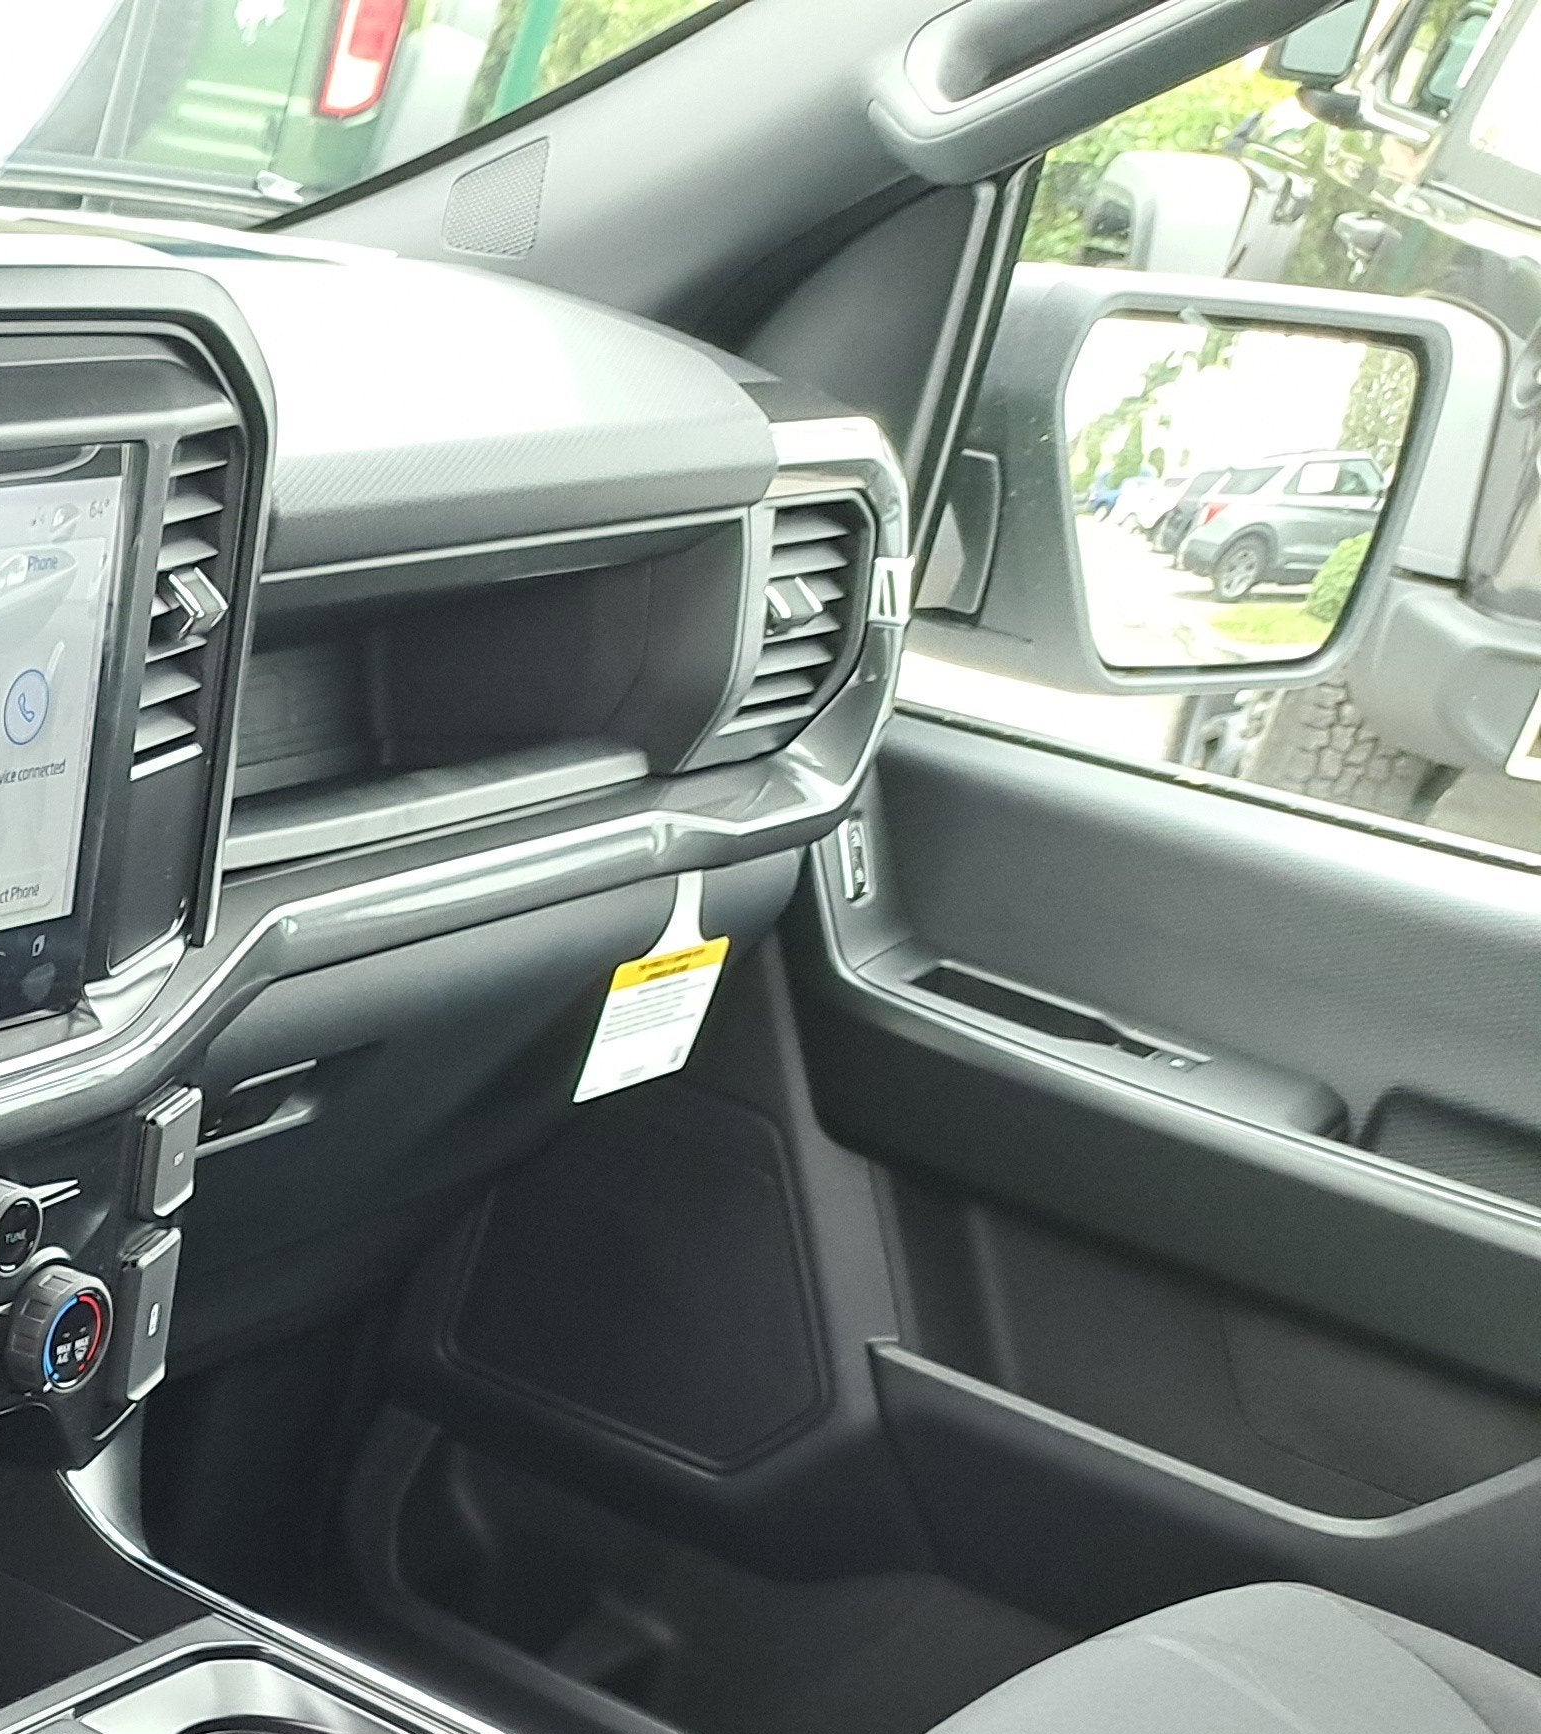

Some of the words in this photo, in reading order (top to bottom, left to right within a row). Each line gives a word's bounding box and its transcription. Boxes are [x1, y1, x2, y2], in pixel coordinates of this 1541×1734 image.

[27, 555, 58, 572] Phone
[17, 760, 66, 782] connected
[10, 884, 40, 901] Phone
